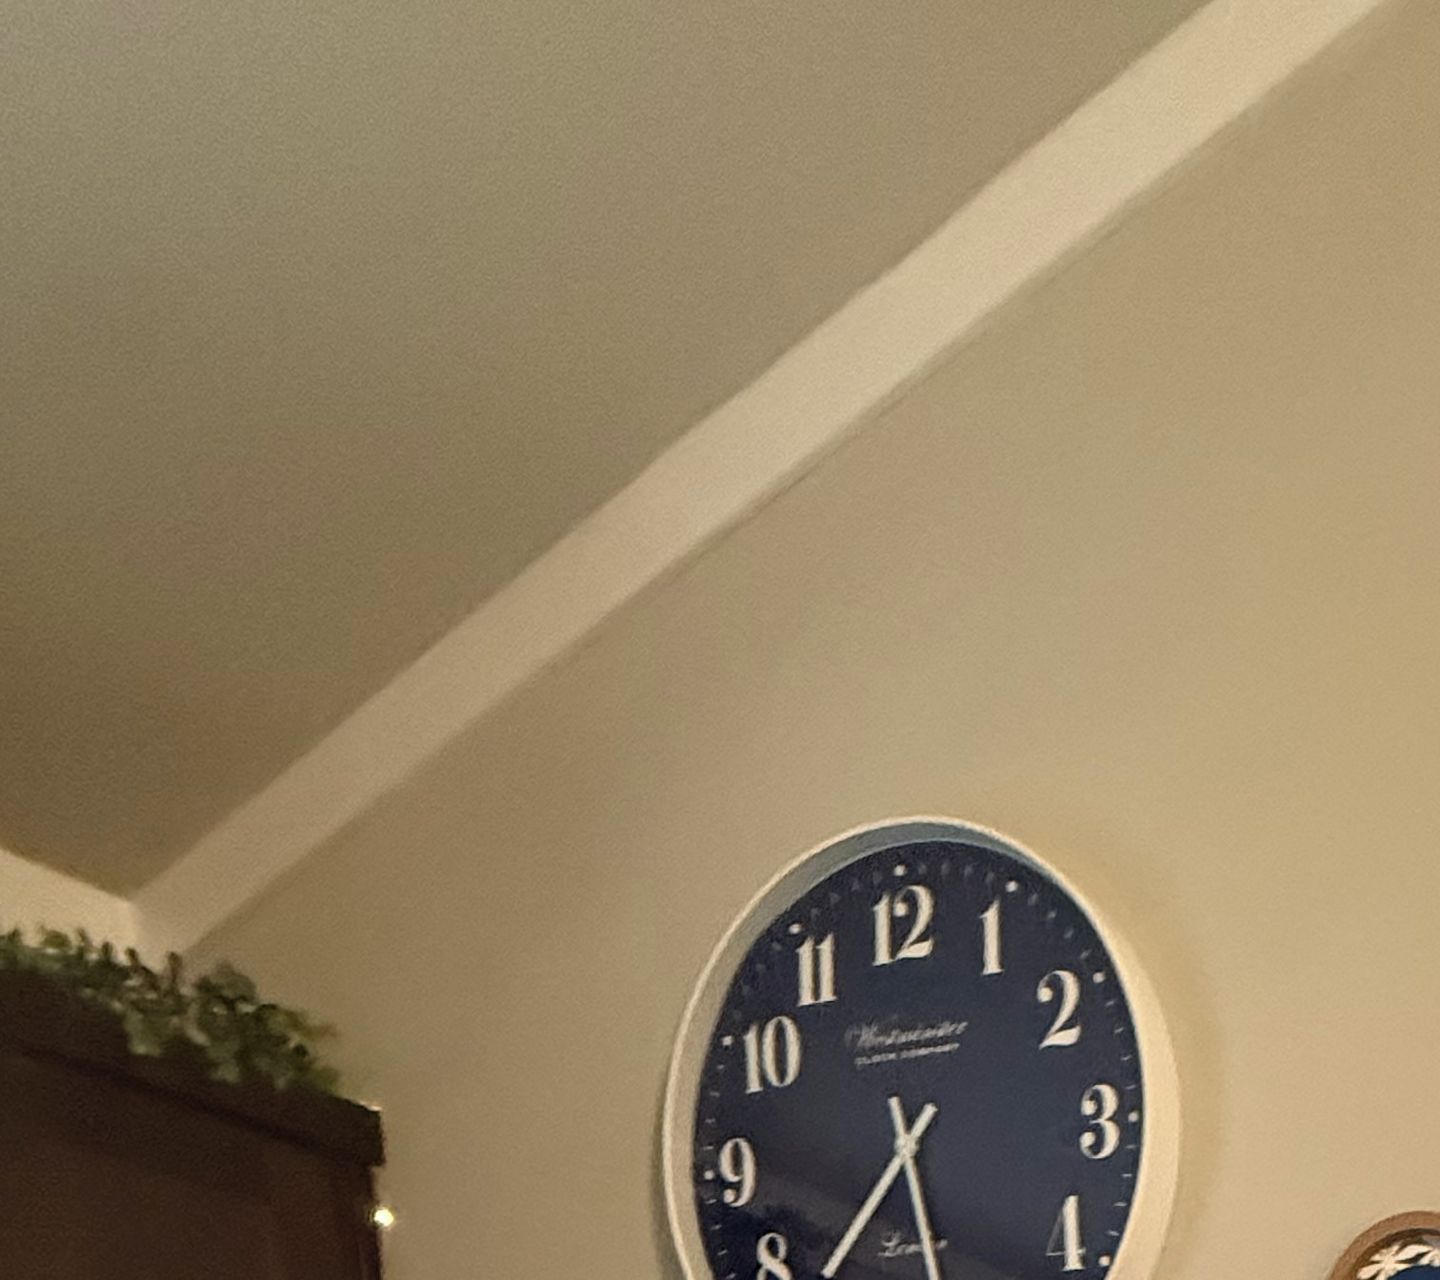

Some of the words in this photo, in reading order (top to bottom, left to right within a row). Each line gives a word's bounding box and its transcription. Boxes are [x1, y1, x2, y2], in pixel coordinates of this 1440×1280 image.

[871, 884, 935, 967] 12
[981, 899, 1004, 977] 1
[796, 933, 838, 1007] 11
[1037, 970, 1082, 1050] 2
[743, 1015, 800, 1095] 10
[1080, 1083, 1120, 1159] 3
[718, 1137, 758, 1207] 9
[1046, 1195, 1086, 1271] 4
